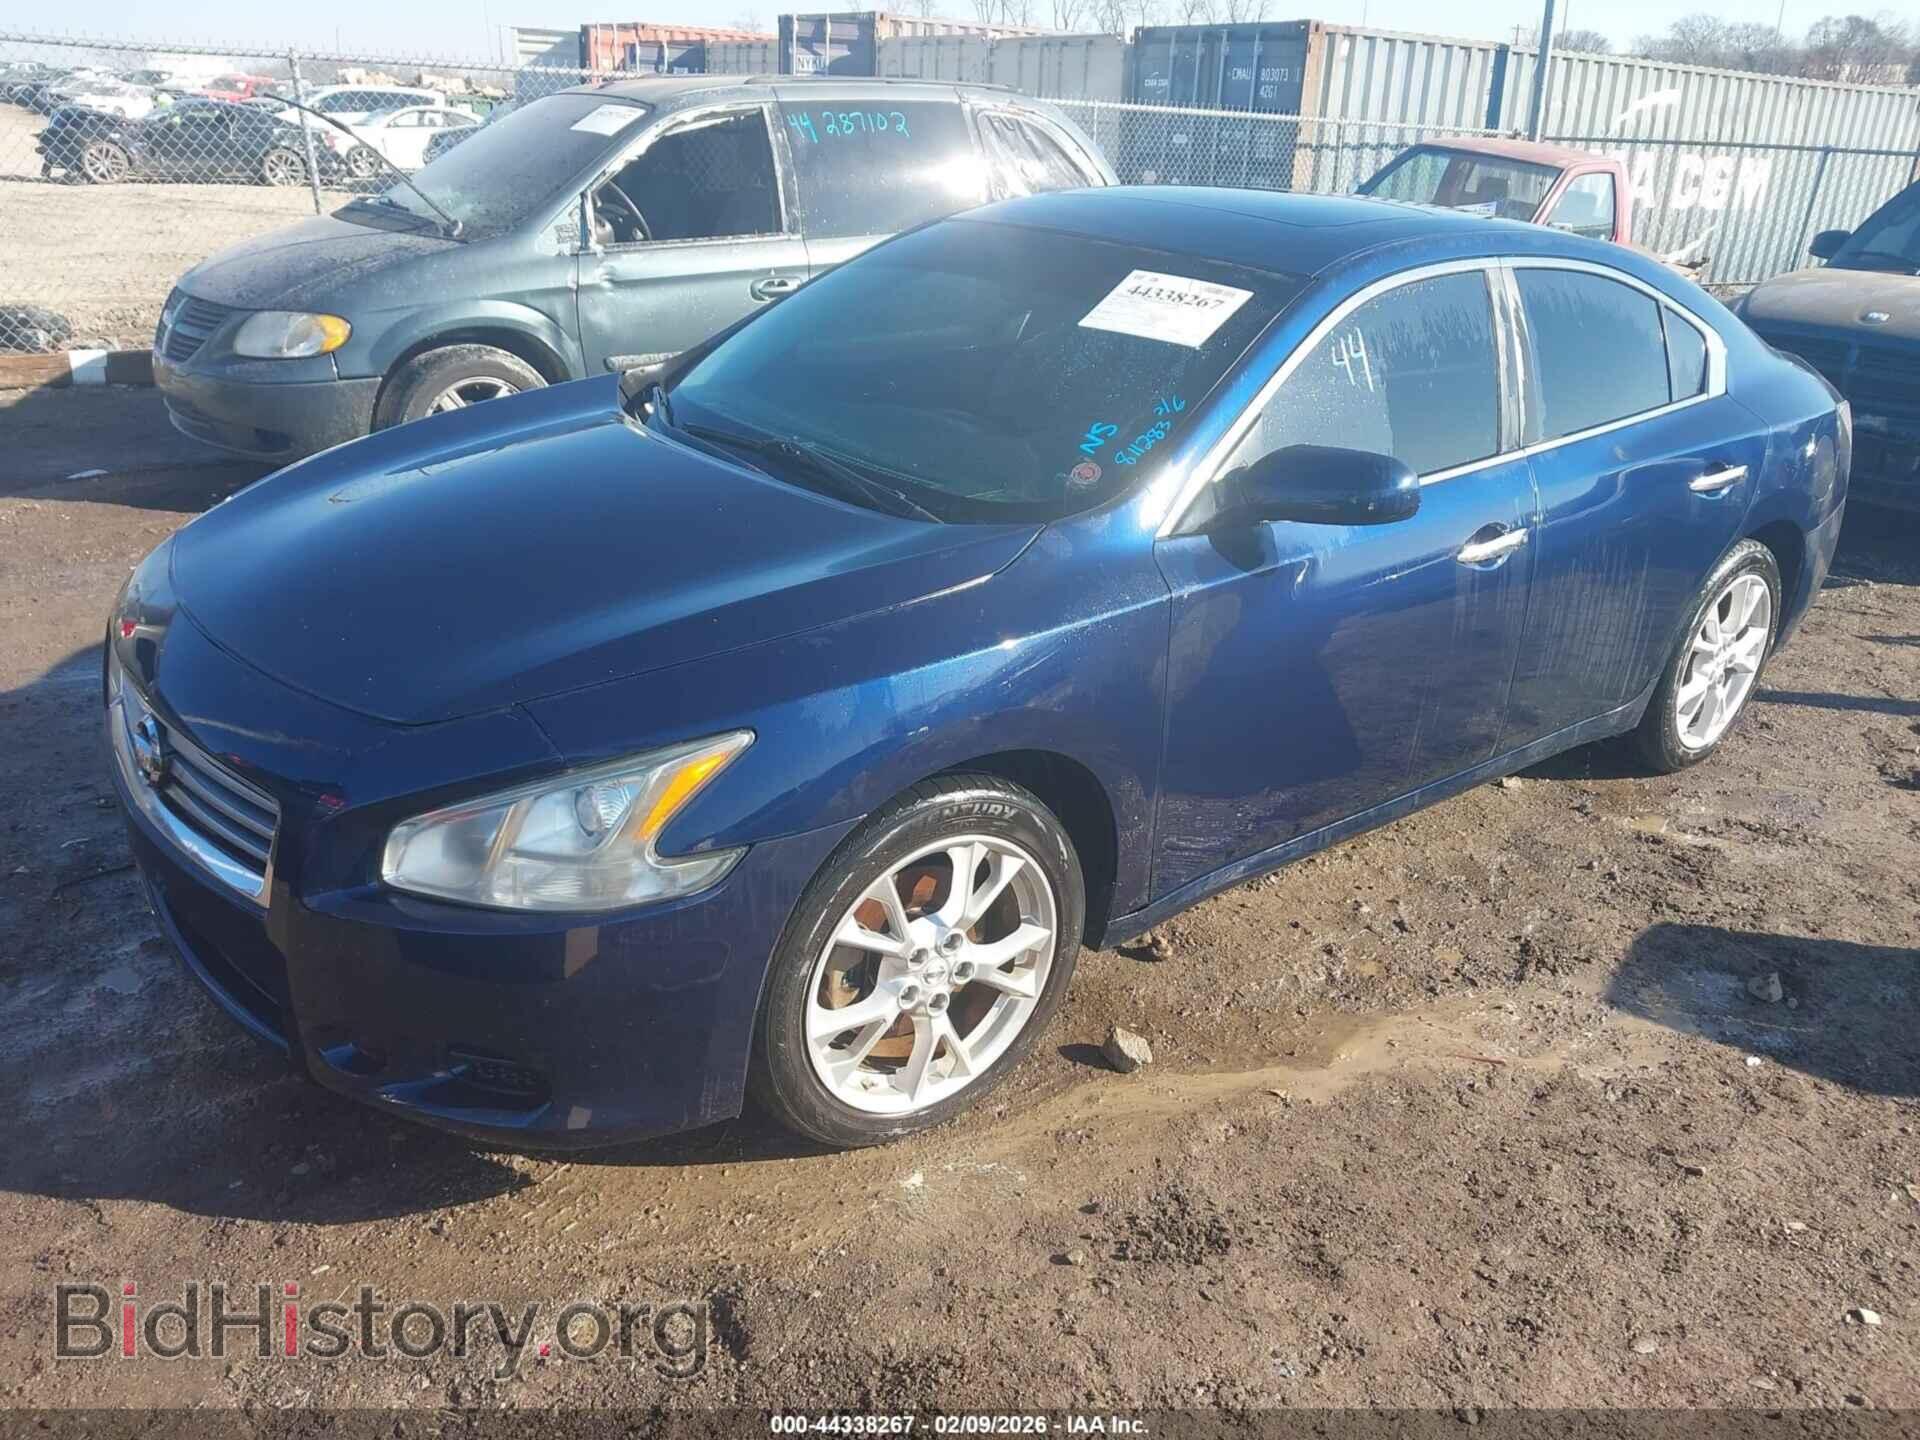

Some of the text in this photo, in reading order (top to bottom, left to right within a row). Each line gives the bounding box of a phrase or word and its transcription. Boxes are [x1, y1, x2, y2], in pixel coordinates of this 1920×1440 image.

[1260, 67, 1289, 81] 803073
[786, 111, 910, 143] 44 287102
[1669, 153, 1772, 210] CGM
[1127, 284, 1225, 310] 44338267
[1331, 326, 1374, 392] 44
[1079, 422, 1118, 455] NS
